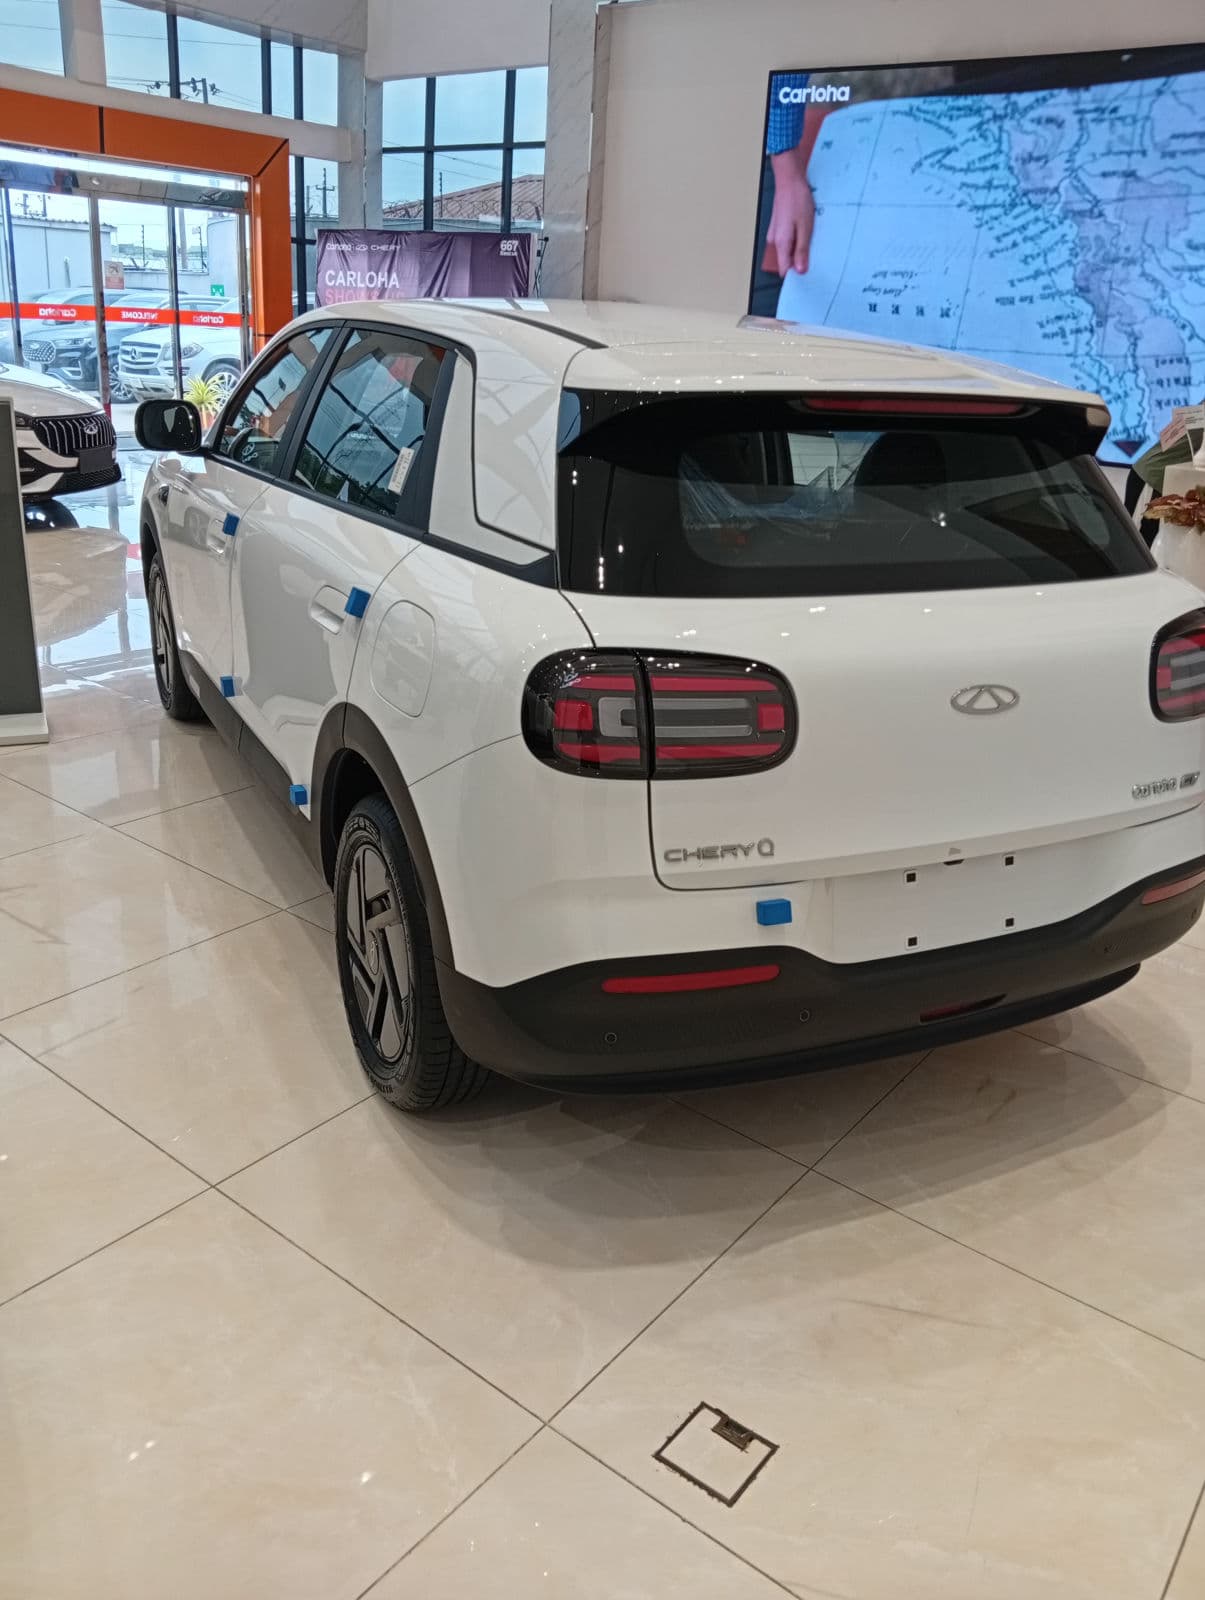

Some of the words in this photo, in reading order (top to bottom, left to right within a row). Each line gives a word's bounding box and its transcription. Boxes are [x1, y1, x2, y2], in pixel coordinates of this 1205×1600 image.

[778, 84, 851, 104] Carloha
[500, 240, 519, 251] 667
[325, 270, 400, 289] CARLOHA
